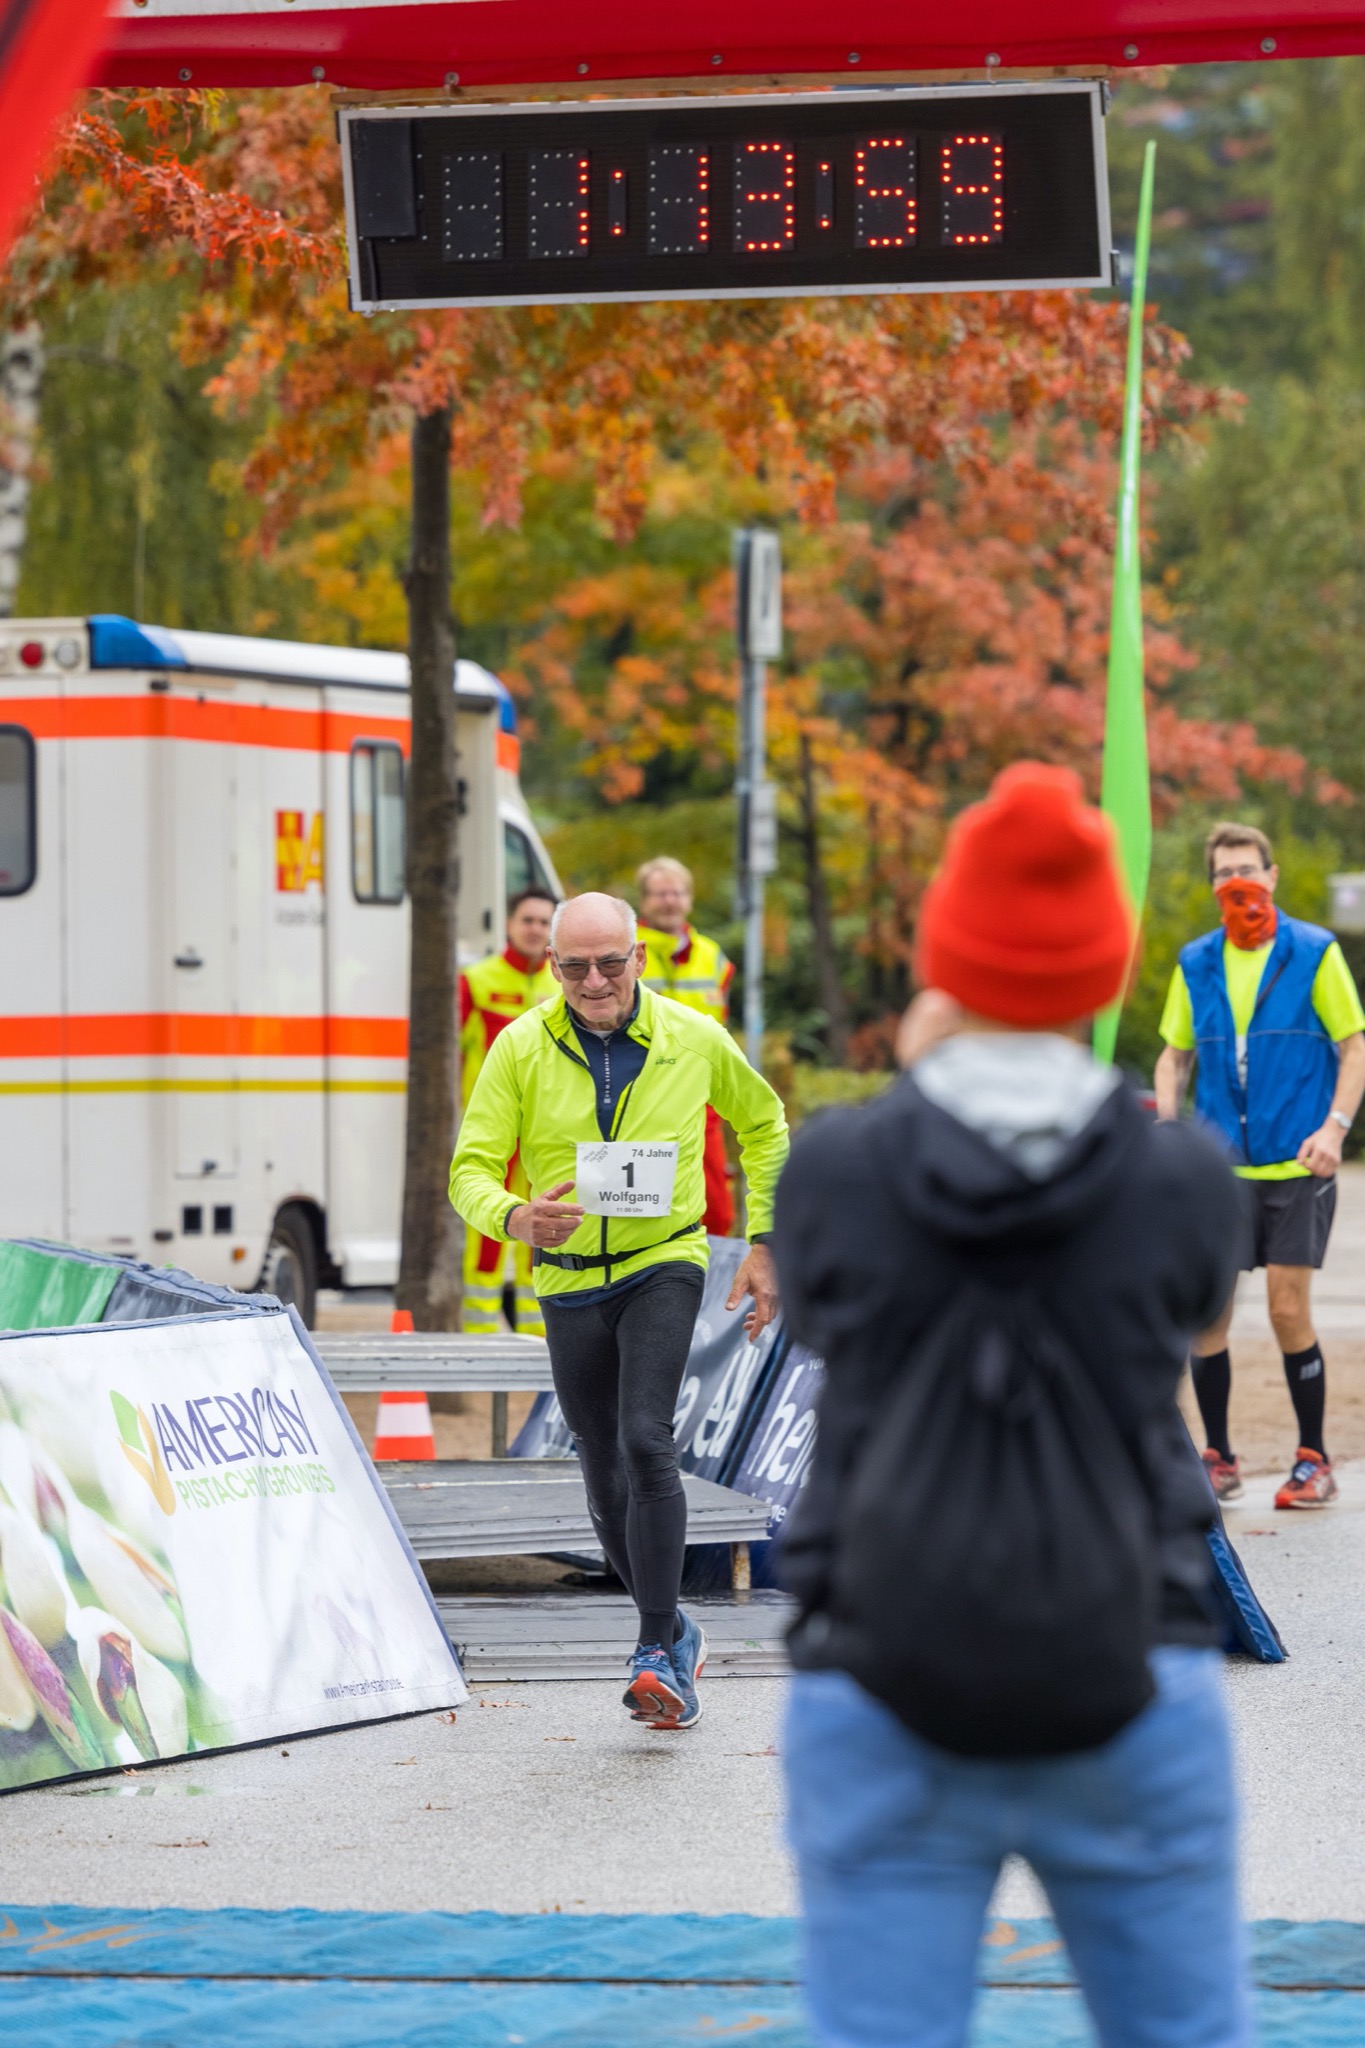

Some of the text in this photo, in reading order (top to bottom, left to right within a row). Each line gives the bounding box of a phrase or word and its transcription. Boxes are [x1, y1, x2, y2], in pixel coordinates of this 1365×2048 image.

[632, 1149, 673, 1158] 74 Jahre
[621, 1162, 634, 1188] 1
[599, 1191, 660, 1205] Wolfgang
[151, 1387, 319, 1472] AMERICAN
